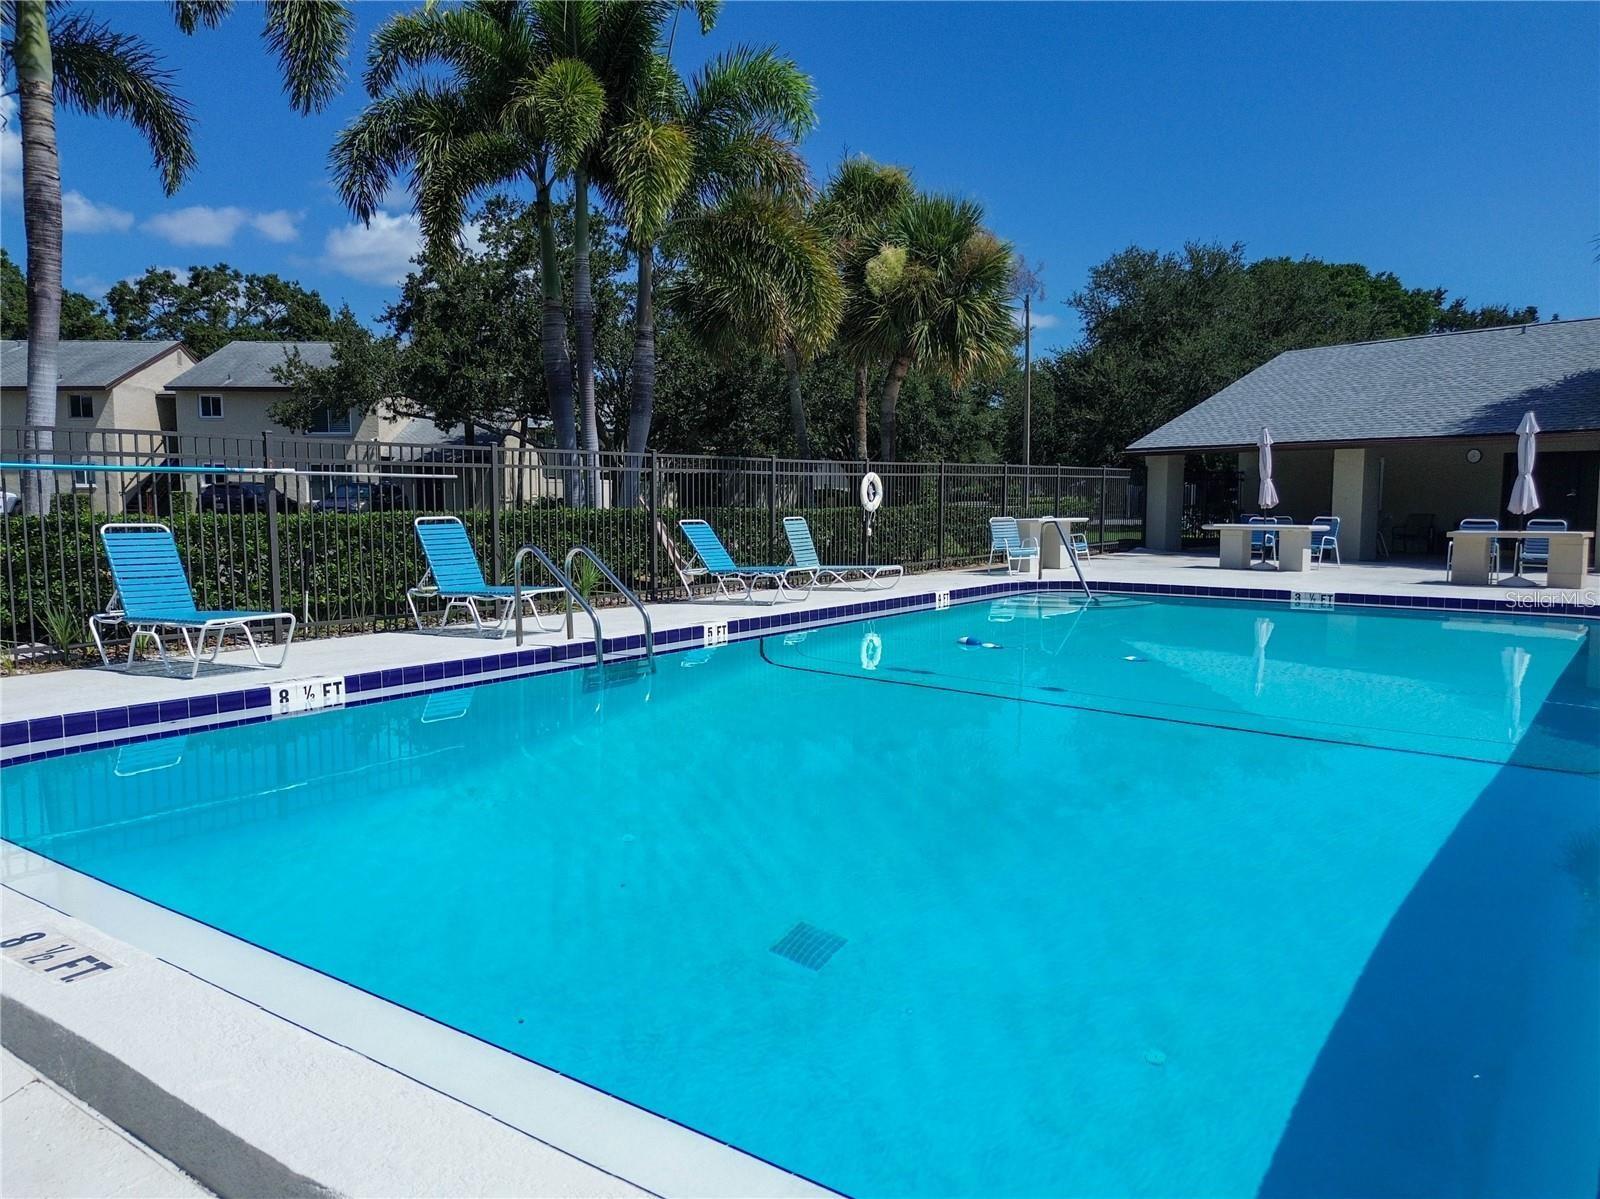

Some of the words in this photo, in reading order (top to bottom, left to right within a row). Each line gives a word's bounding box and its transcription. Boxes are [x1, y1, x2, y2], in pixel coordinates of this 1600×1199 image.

[708, 626, 712, 637] 5
[717, 624, 726, 636] FT
[279, 689, 290, 704] 8
[322, 681, 342, 697] FT
[0, 932, 46, 949] 8
